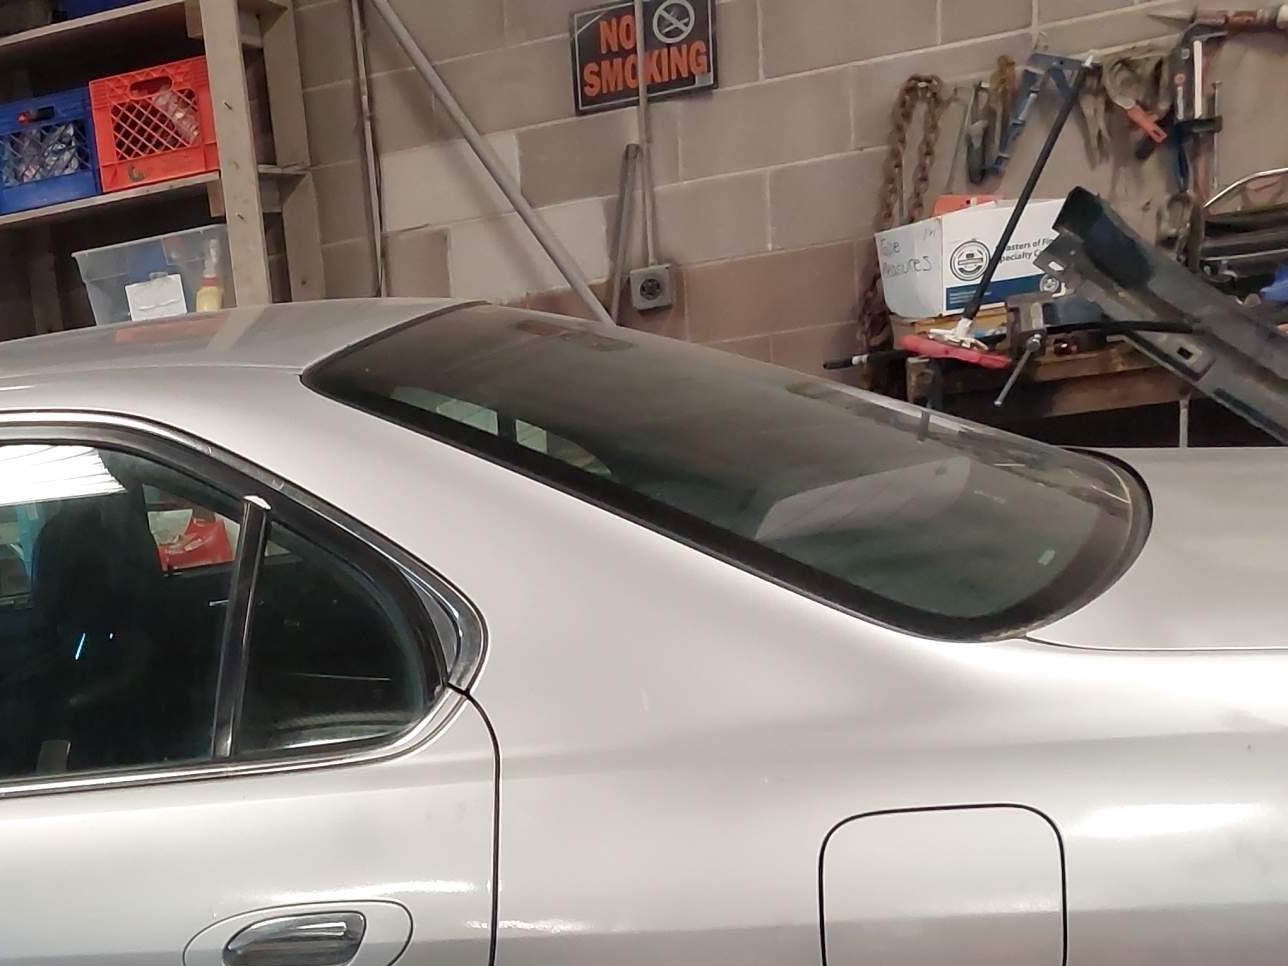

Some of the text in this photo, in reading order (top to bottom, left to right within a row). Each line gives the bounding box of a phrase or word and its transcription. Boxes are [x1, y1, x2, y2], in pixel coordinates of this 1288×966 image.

[599, 14, 636, 54] NO
[583, 40, 708, 97] SMOKING
[999, 251, 1033, 264] pecialty
[1004, 241, 1031, 252] asters
[1032, 238, 1041, 248] of
